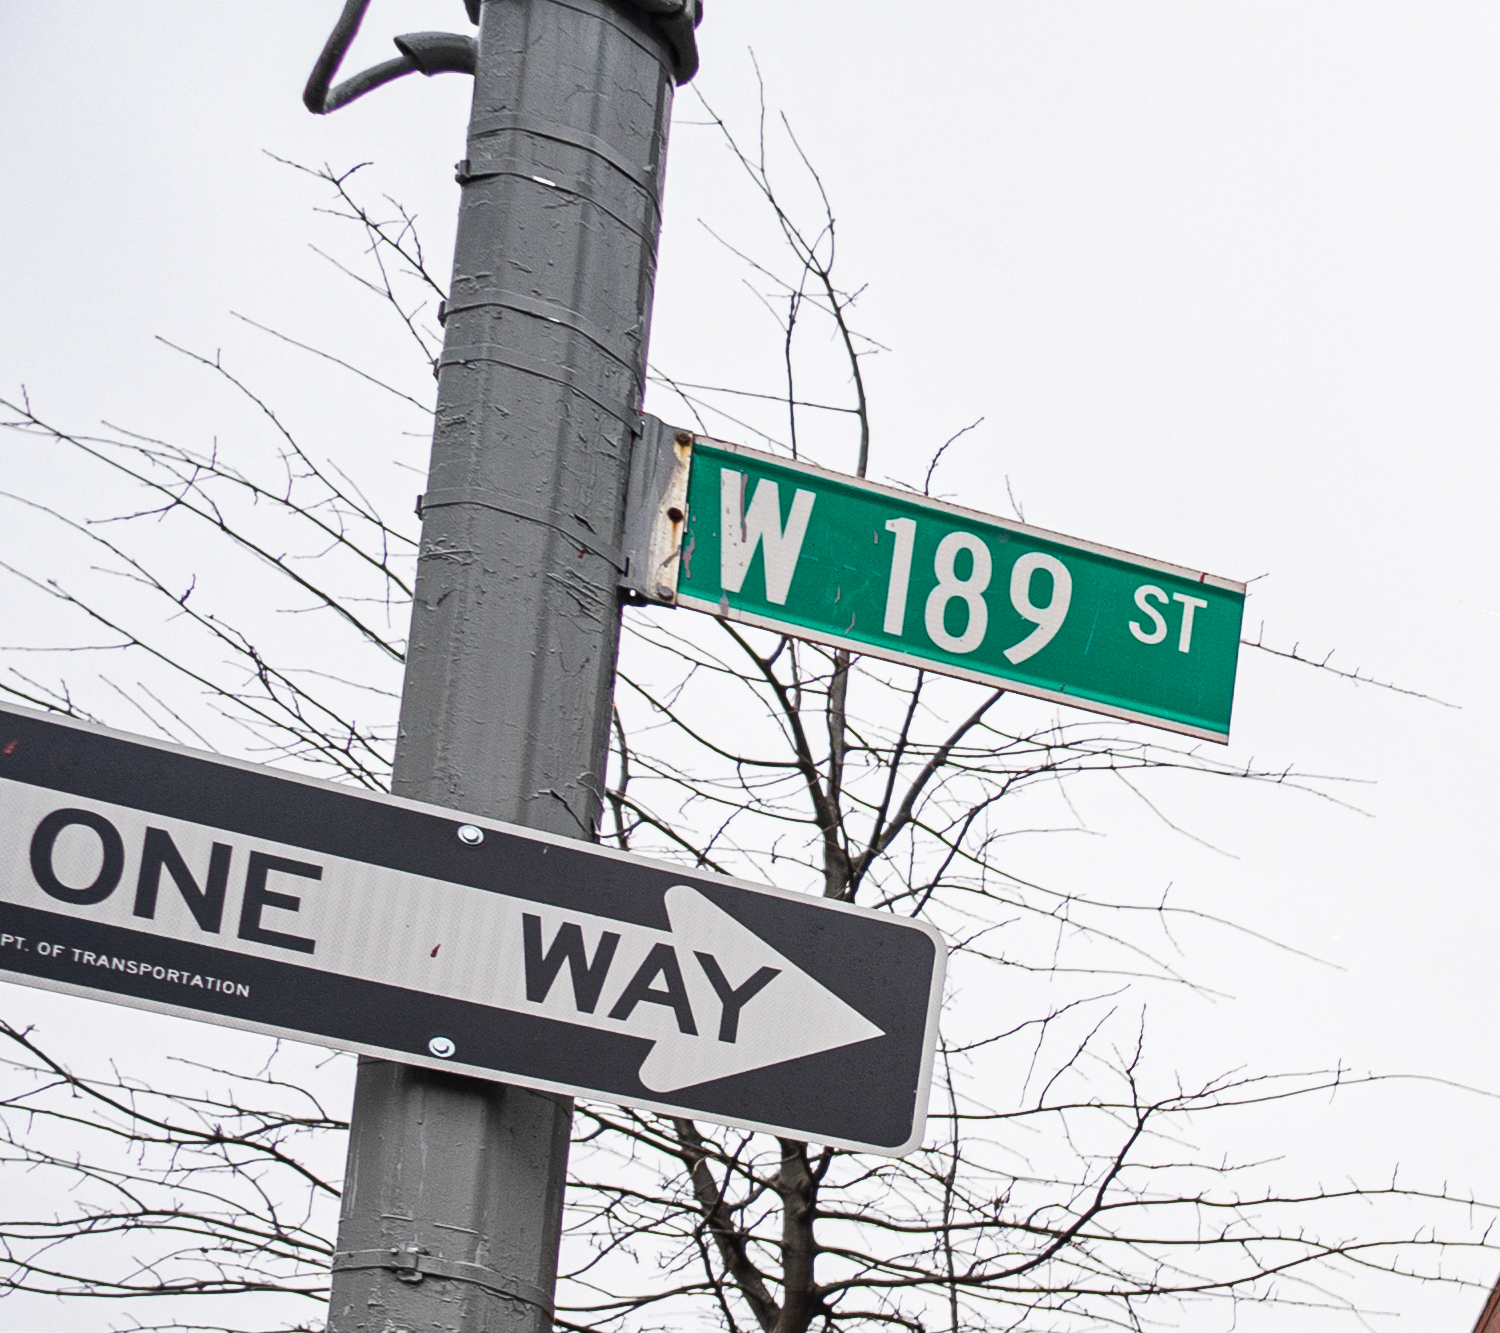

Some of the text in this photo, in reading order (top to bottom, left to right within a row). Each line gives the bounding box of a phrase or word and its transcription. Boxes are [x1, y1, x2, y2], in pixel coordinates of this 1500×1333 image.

[719, 468, 1209, 665] W 189 ST
[29, 806, 782, 1043] ONE WAY
[37, 941, 65, 957] OF
[72, 948, 250, 997] TRANSPORTATION
